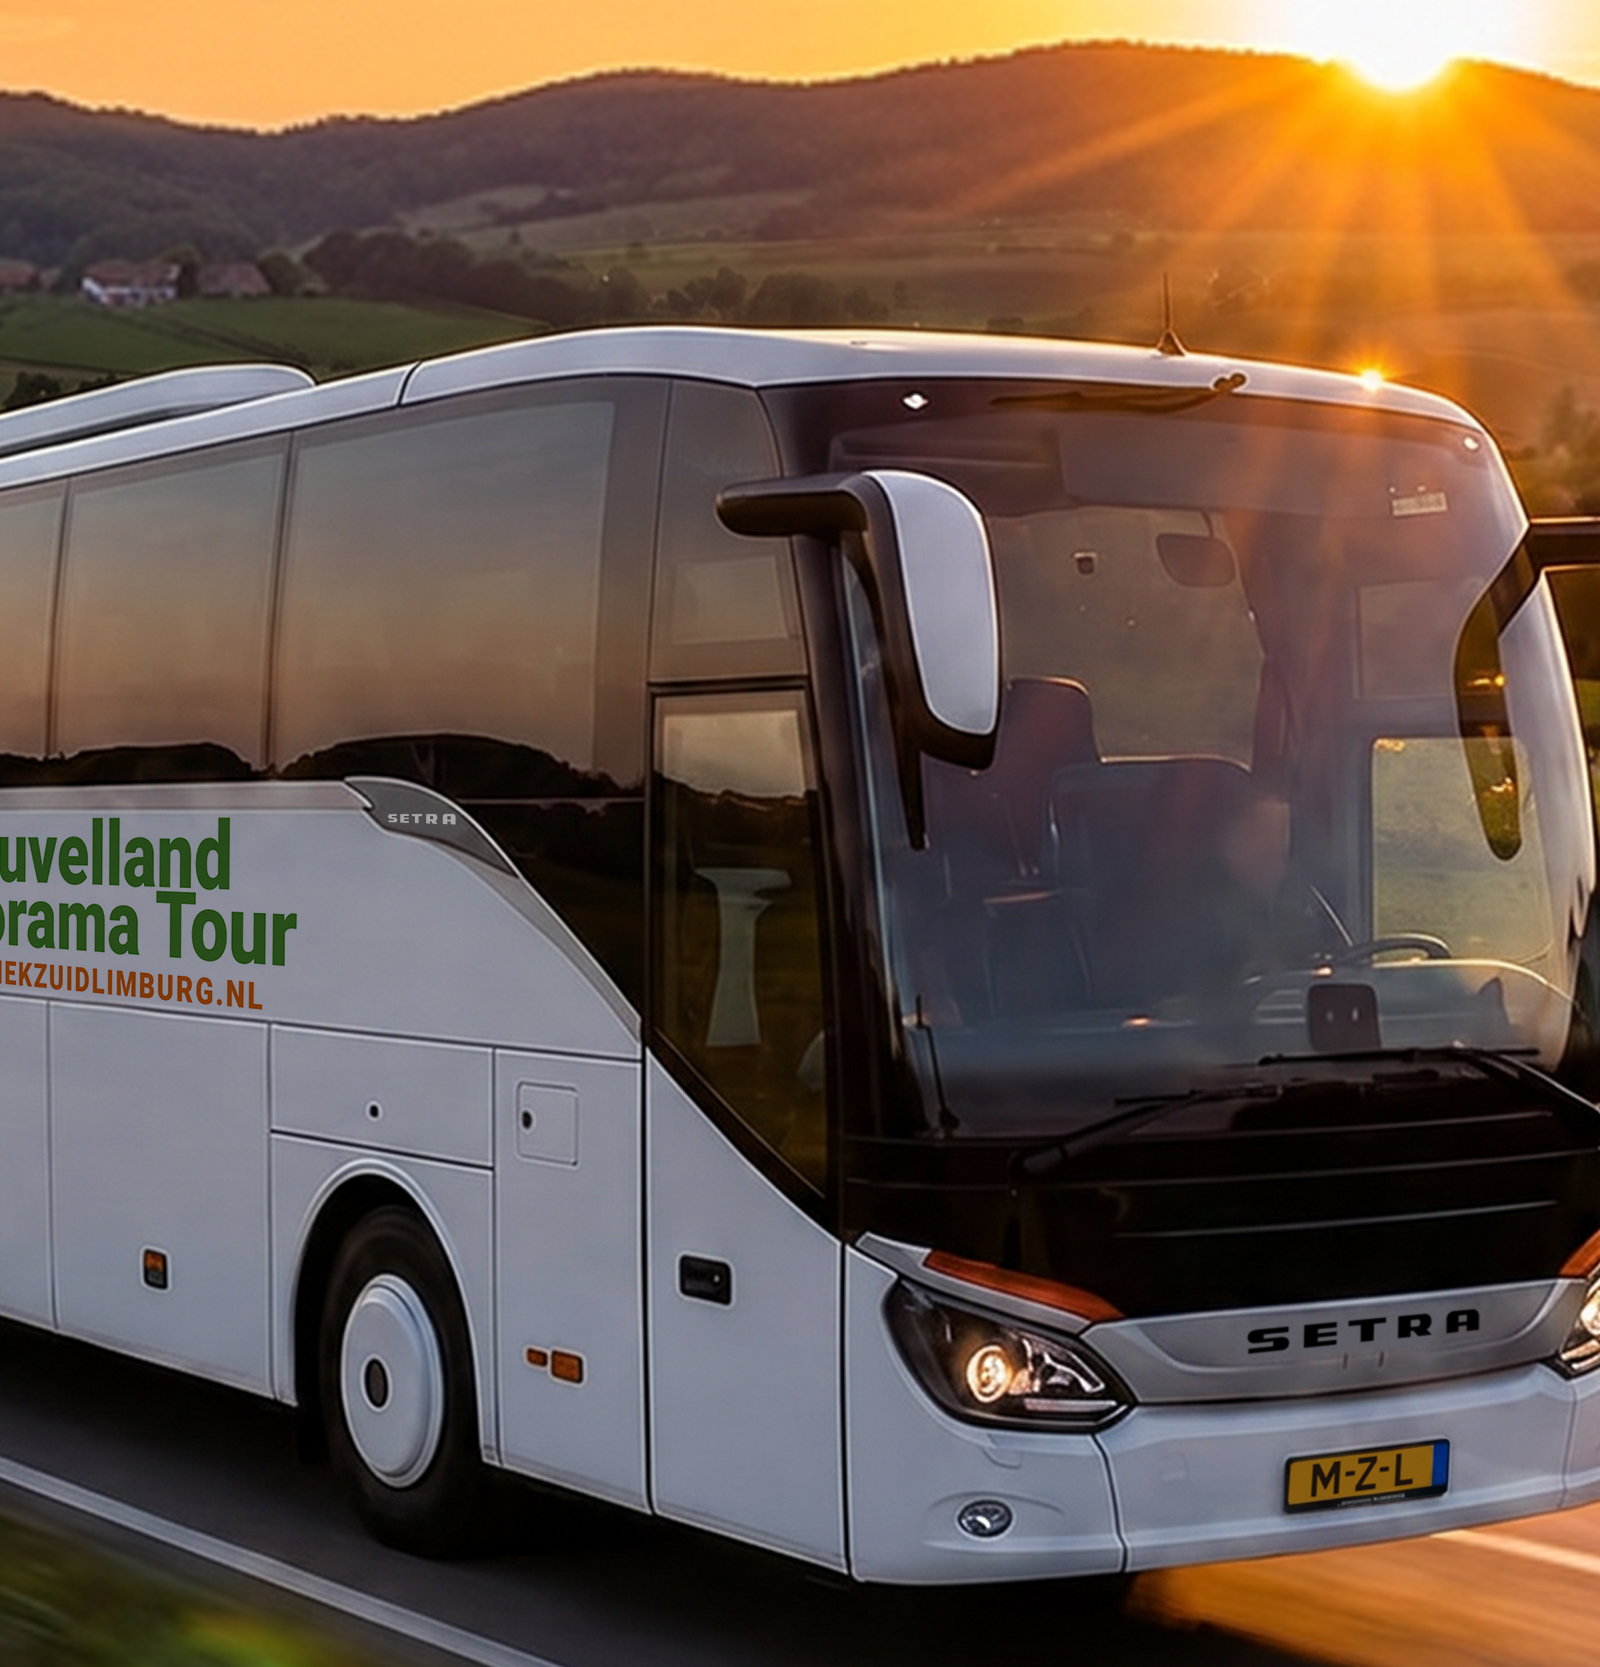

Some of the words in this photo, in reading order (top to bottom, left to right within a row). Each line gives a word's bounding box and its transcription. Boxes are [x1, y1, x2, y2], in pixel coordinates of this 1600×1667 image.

[388, 813, 456, 825] SETRA
[156, 890, 298, 967] Tour
[1247, 1308, 1480, 1354] SETRA
[1311, 1453, 1414, 1498] M-Z-L
